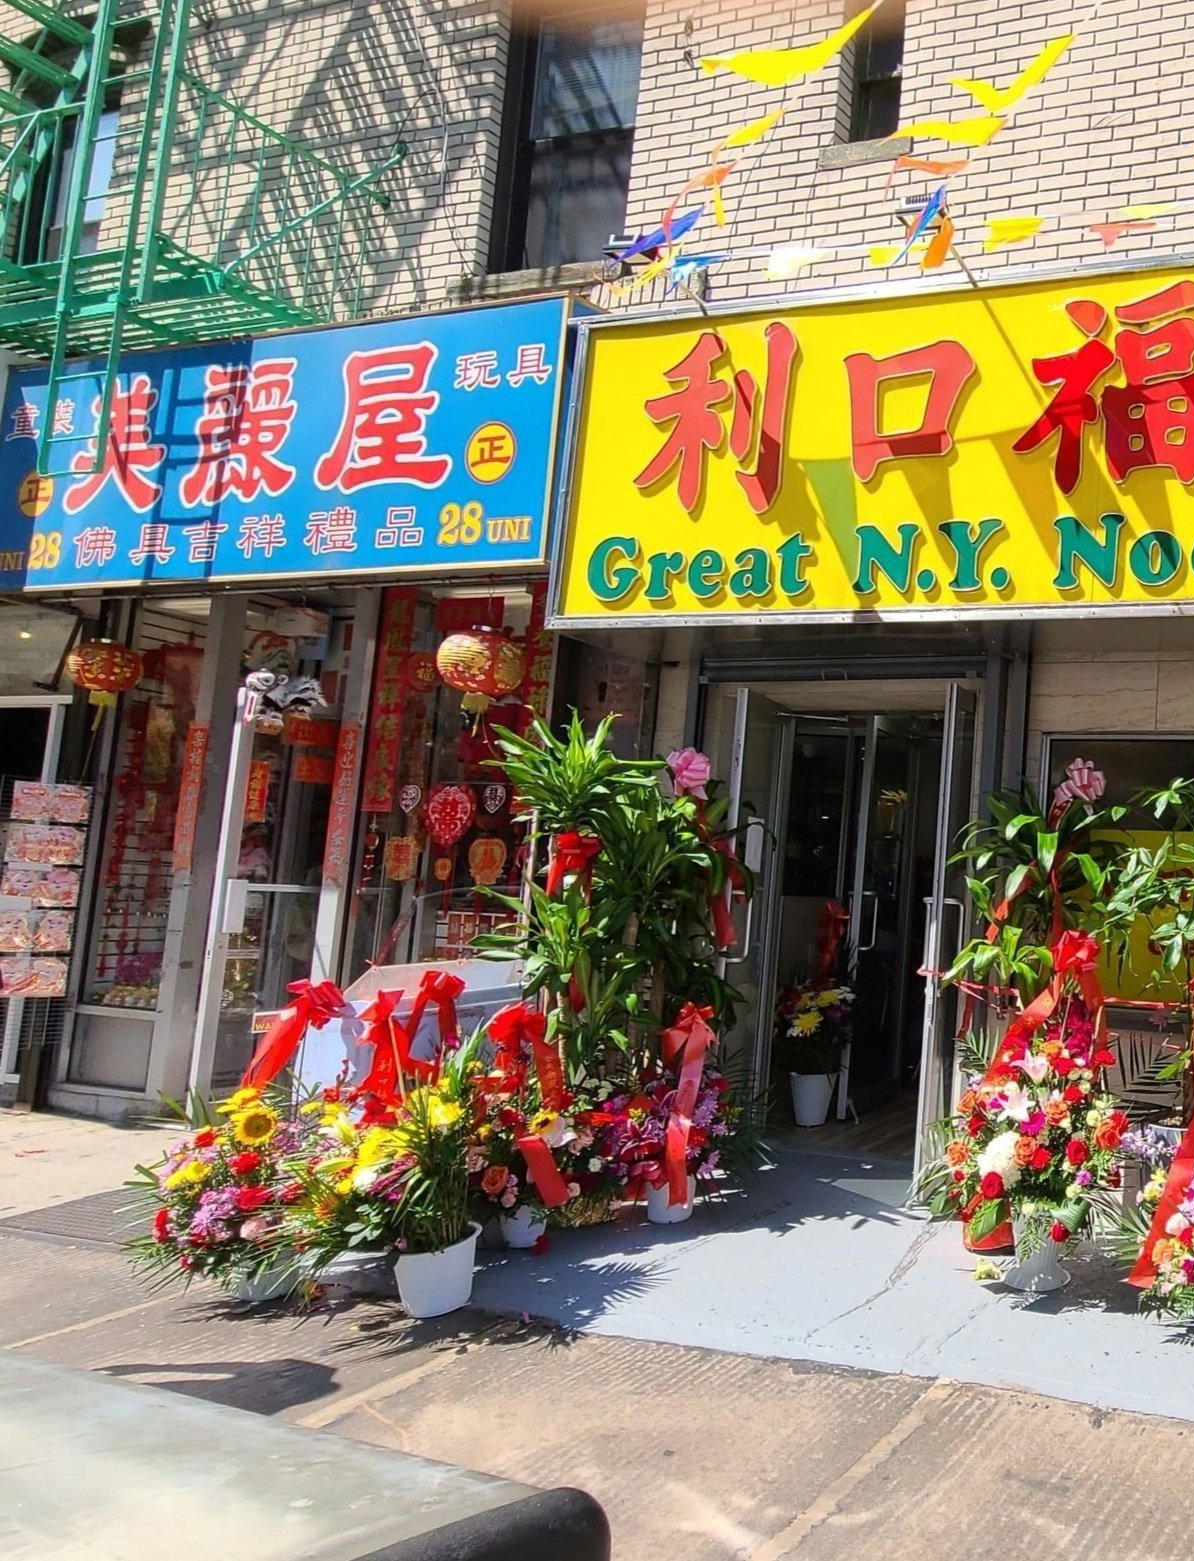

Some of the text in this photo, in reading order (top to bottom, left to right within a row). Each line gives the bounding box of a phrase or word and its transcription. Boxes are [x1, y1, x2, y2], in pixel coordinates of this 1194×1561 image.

[454, 341, 554, 391] 玩具
[62, 340, 453, 516] 美麗屋
[469, 434, 509, 468] 正
[72, 505, 424, 569] 佛具吉祥禮品
[438, 499, 532, 547] 28 UNI
[28, 532, 63, 570] 28
[587, 530, 814, 602] Great
[852, 517, 1012, 596] N.Y.
